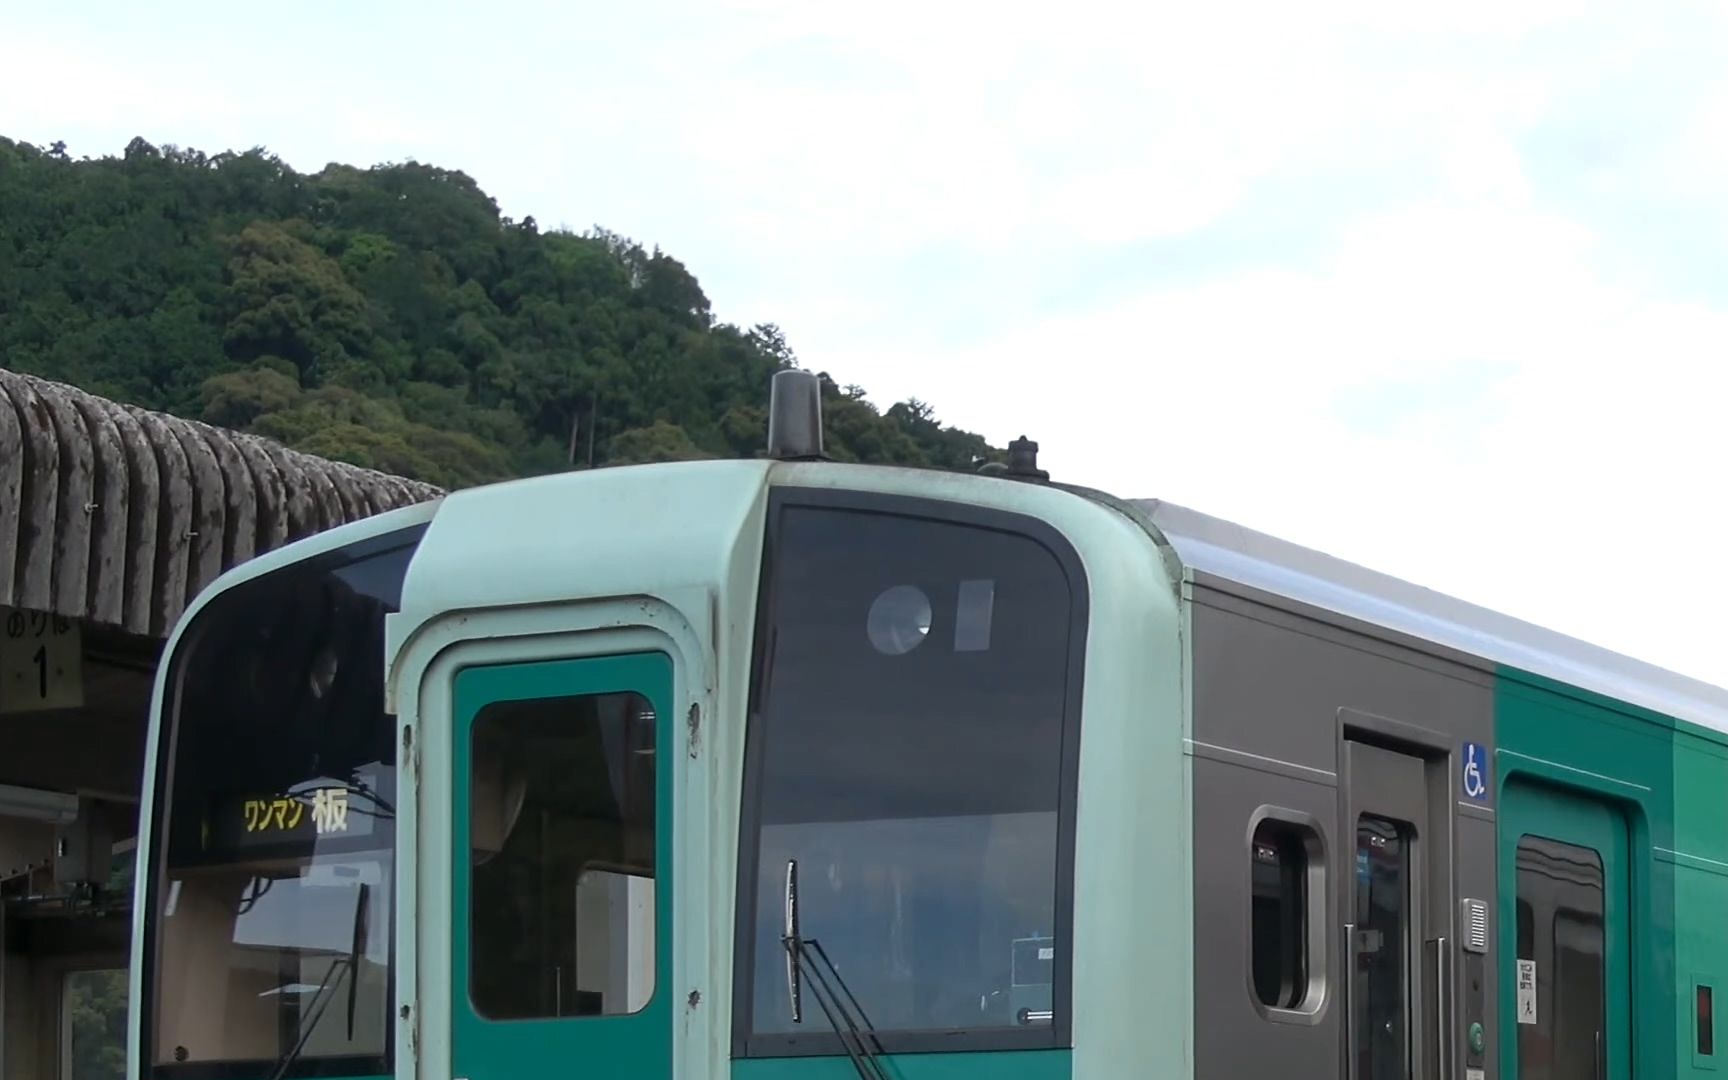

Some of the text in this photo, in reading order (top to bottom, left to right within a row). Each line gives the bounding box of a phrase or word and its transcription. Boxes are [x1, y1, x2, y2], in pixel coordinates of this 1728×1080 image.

[33, 644, 47, 699] 1
[245, 799, 304, 832] ワンマン
